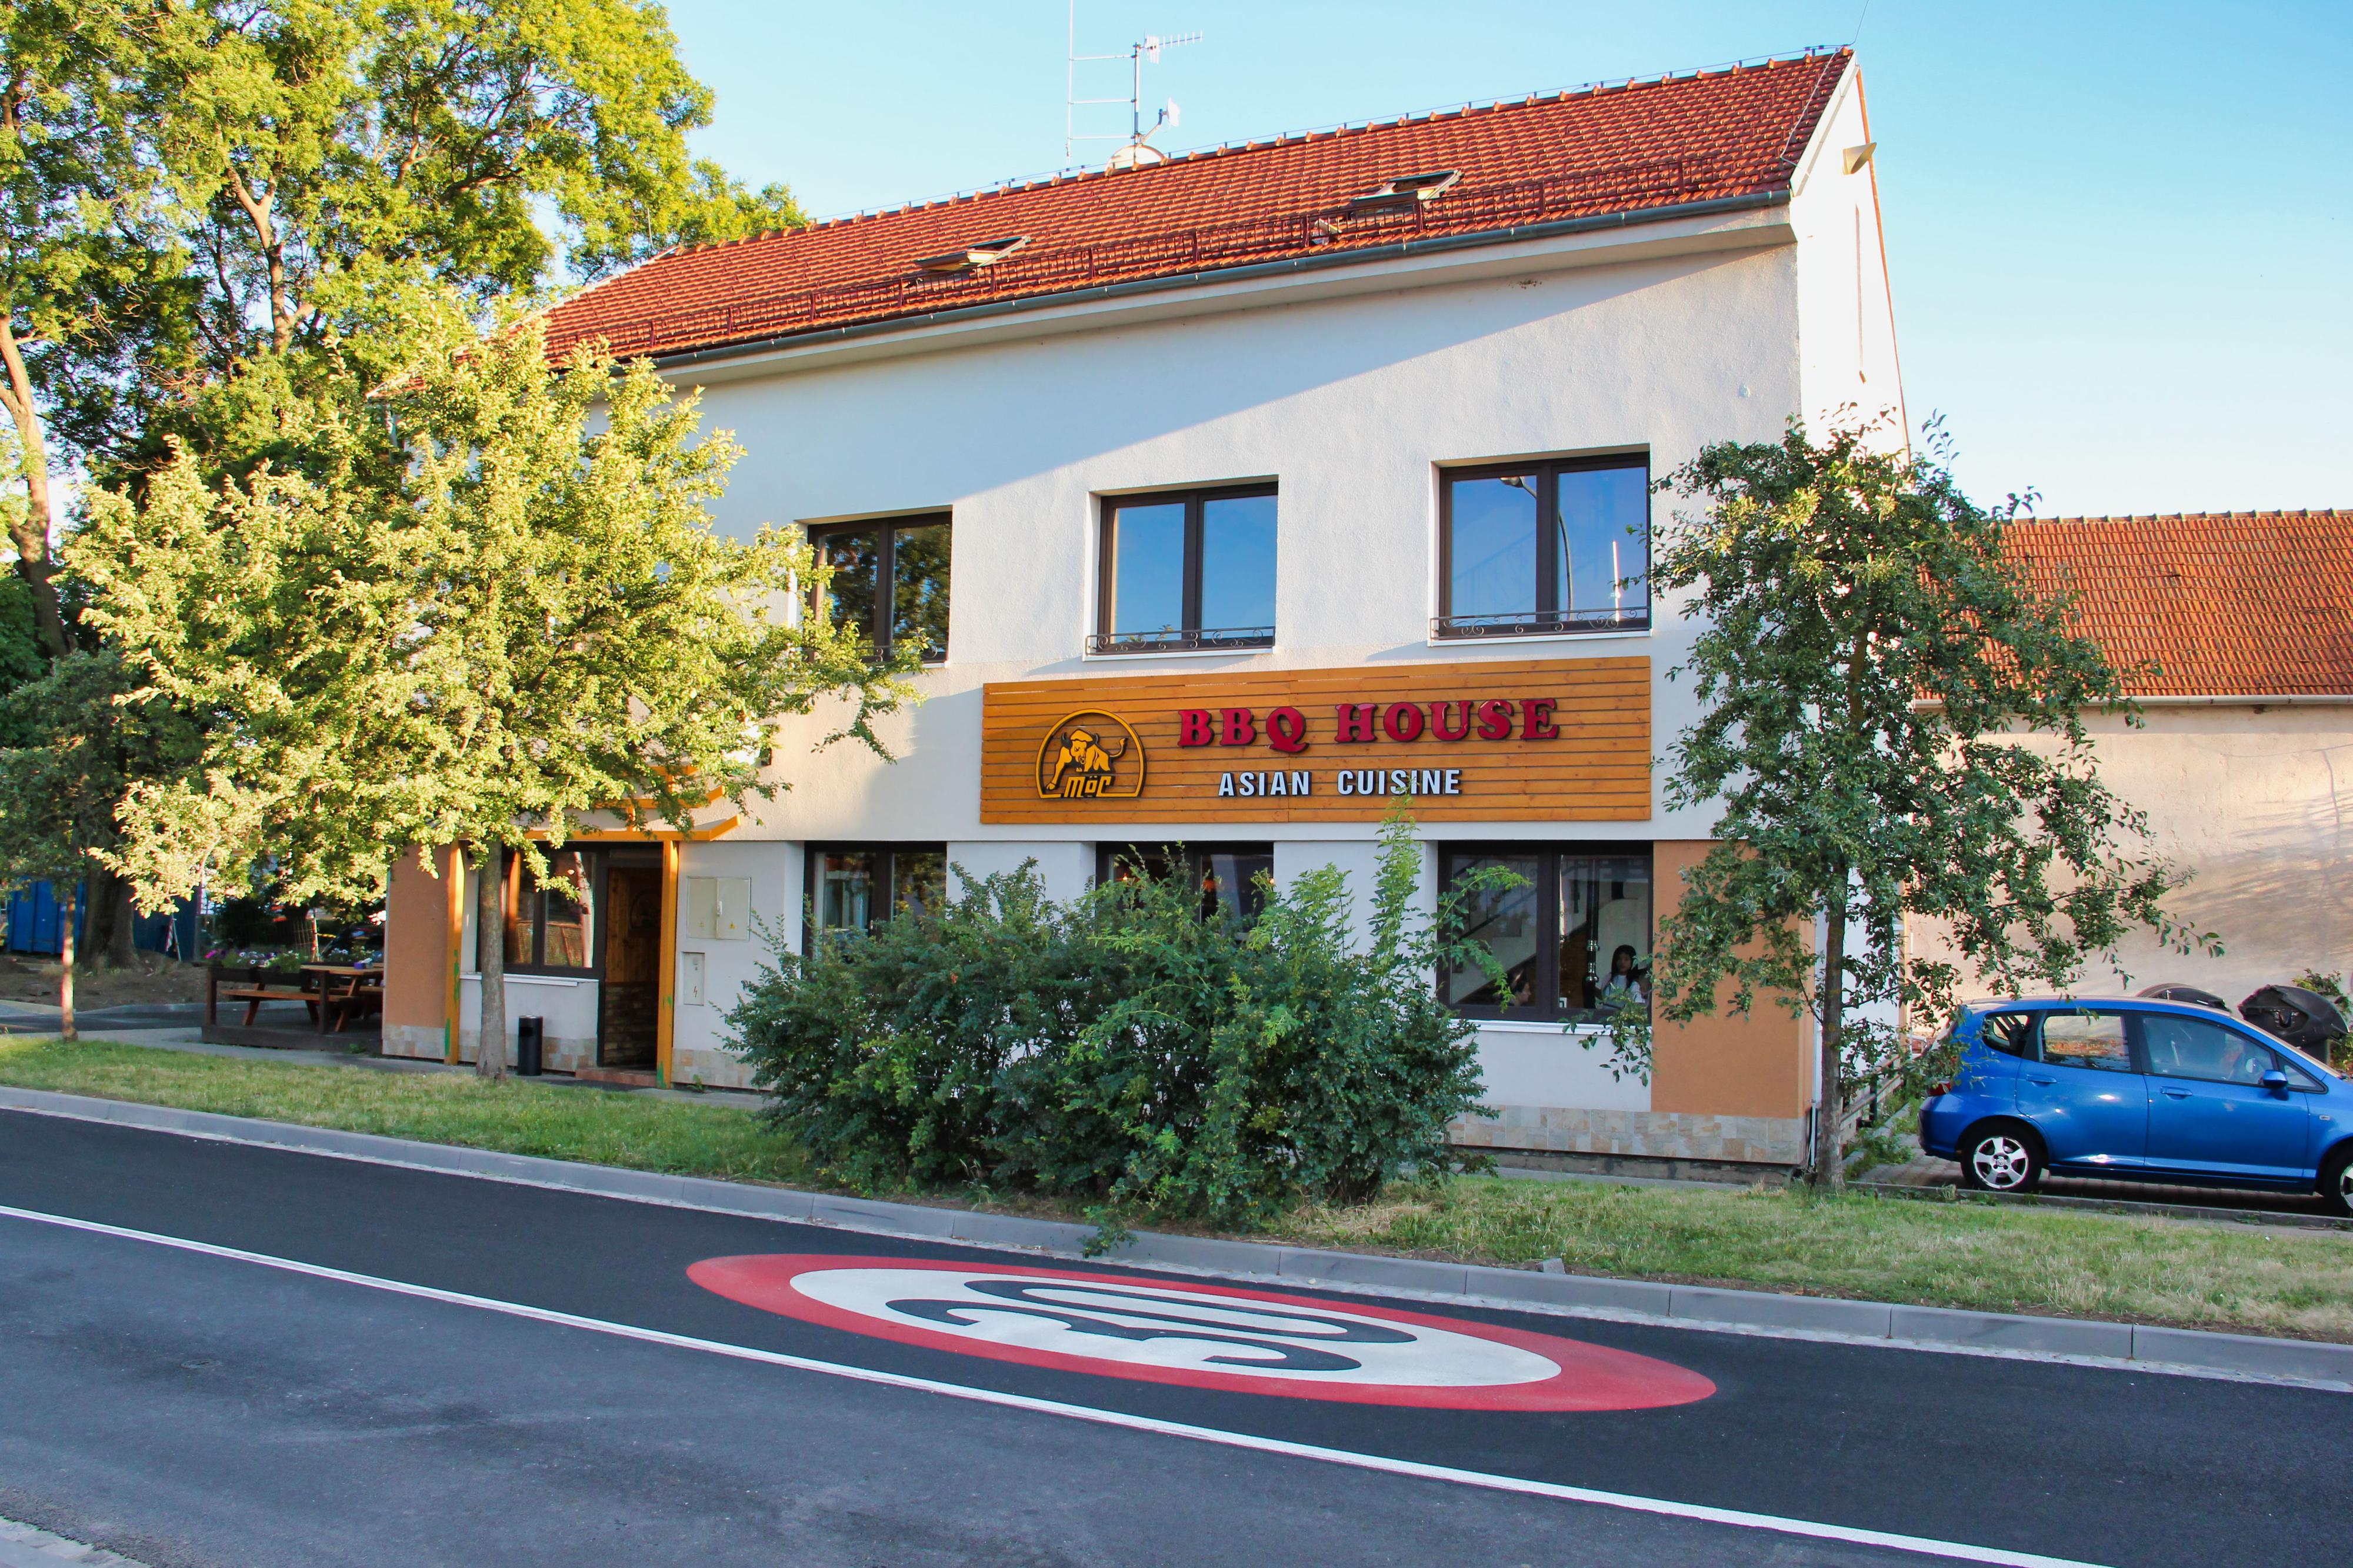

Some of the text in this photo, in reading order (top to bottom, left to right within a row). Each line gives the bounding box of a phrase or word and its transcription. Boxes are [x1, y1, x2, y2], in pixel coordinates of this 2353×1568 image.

[1177, 698, 1560, 753] BBQ HOUSE
[1218, 769, 1462, 796] ASIAN CUISINE
[885, 1280, 1418, 1370] 30
